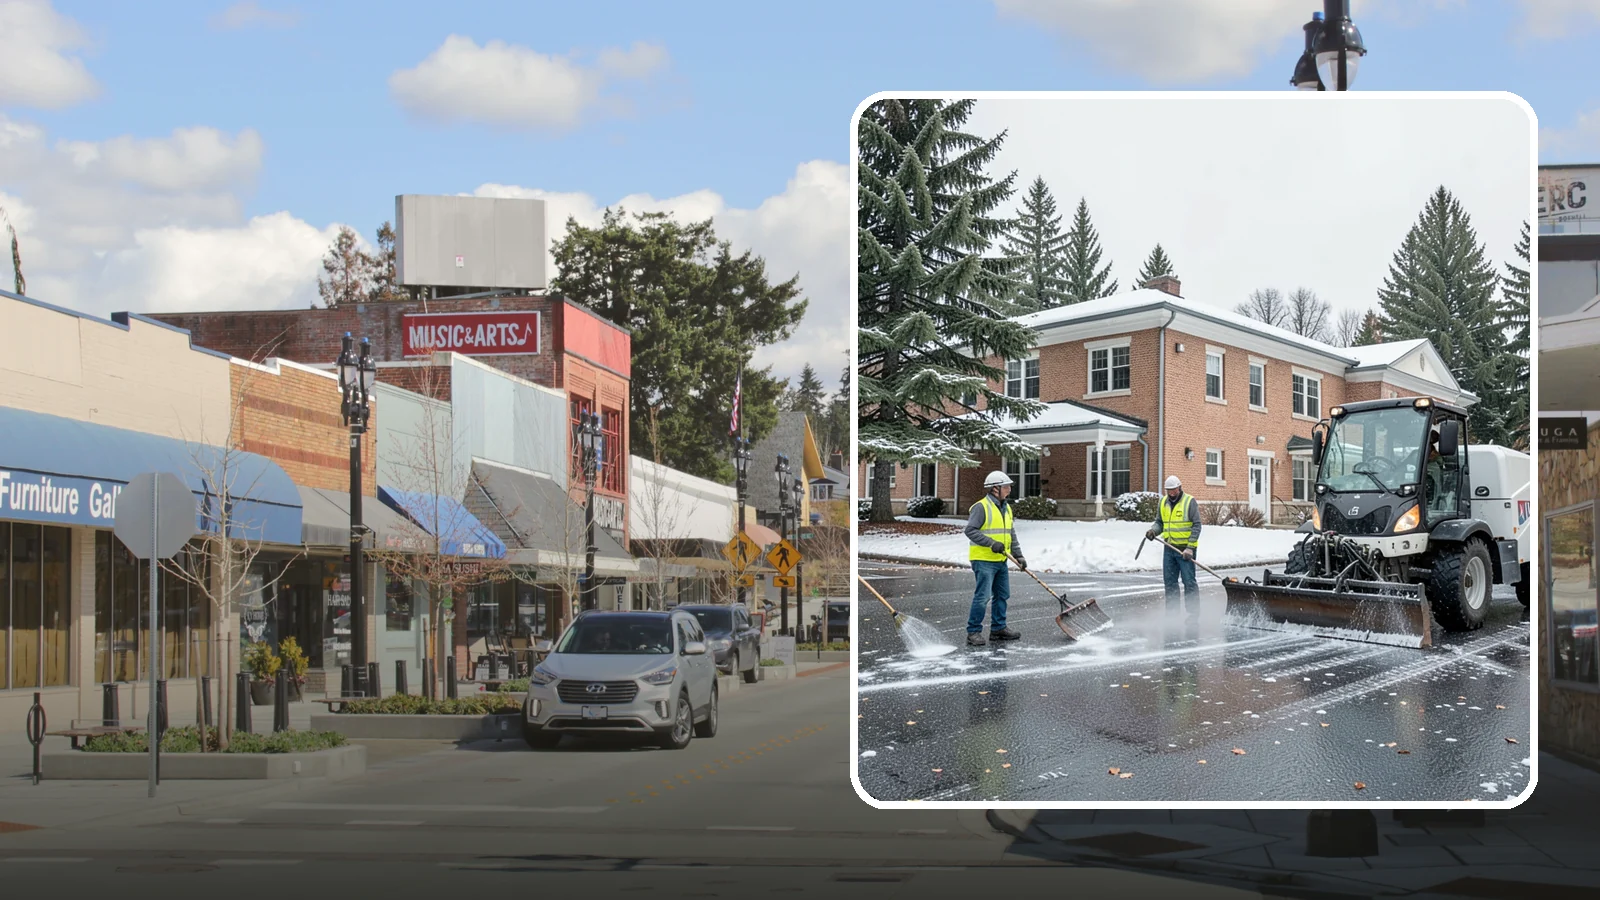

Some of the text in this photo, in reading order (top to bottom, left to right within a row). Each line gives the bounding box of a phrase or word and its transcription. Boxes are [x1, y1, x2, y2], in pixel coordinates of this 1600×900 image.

[0, 471, 122, 519] Furniture Gal
[453, 563, 480, 574] SUSHI
